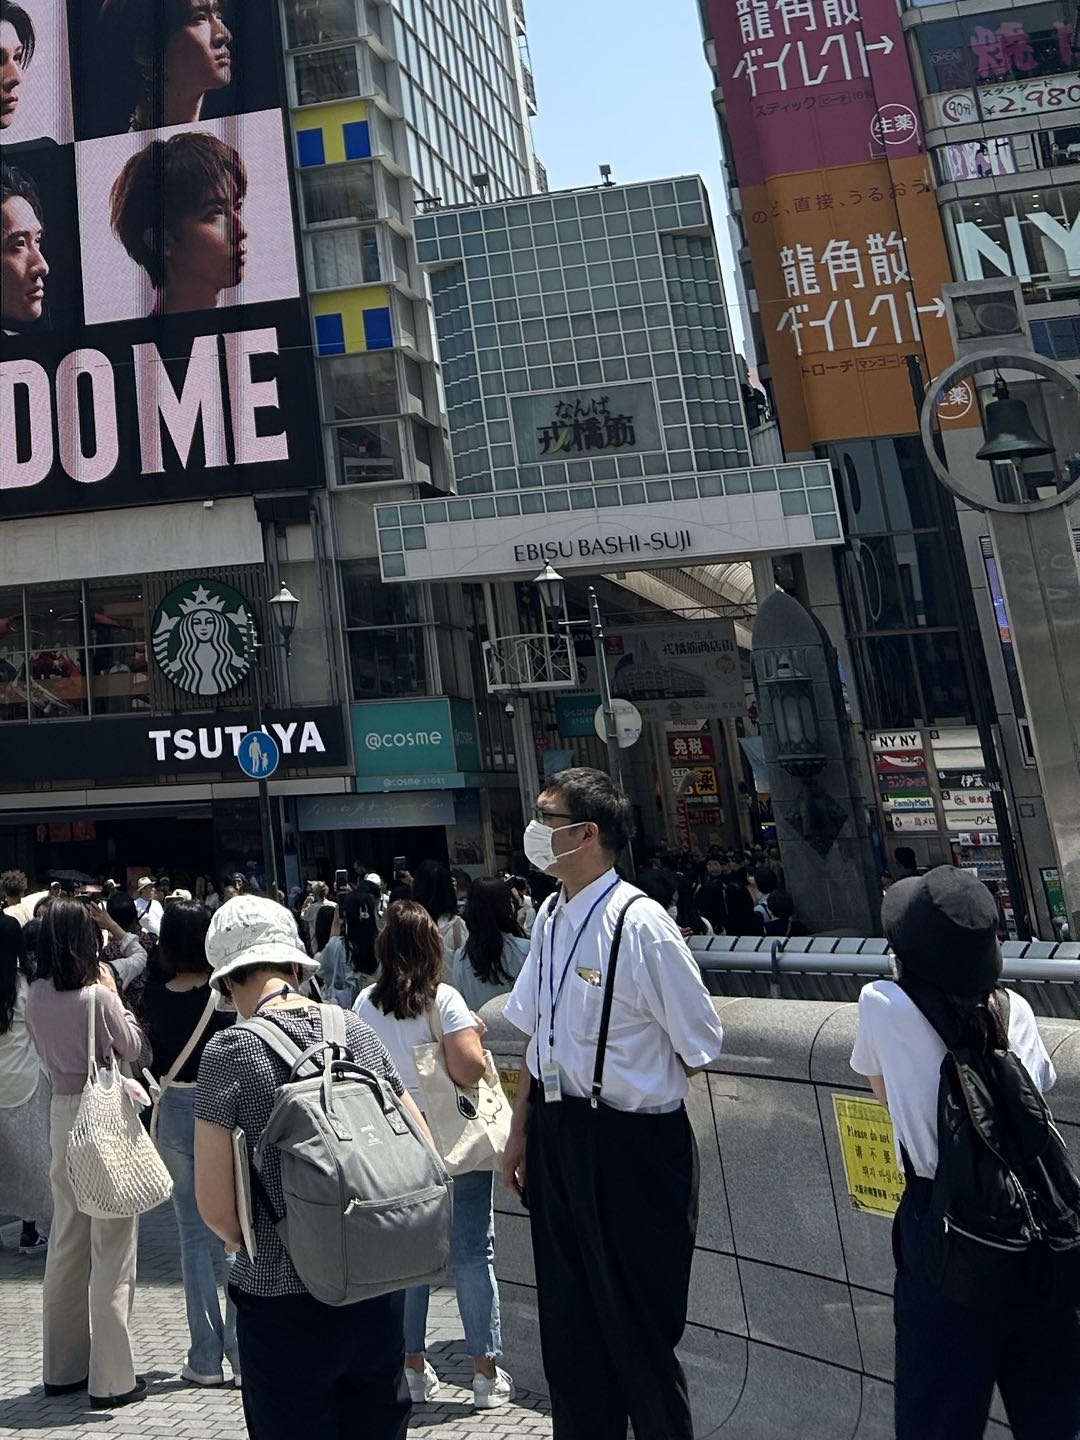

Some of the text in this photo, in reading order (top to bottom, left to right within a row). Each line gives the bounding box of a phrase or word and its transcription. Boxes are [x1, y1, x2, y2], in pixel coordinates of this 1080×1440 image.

[732, 31, 894, 97] ダイレクト
[982, 80, 1054, 97] スタンダード
[874, 114, 914, 137] 生薬
[780, 231, 914, 298] 龍角散
[776, 291, 946, 356] ダイレクト
[801, 361, 854, 378] トローチ
[555, 396, 610, 419] なんば
[536, 415, 636, 455] 戎橋筋
[514, 540, 573, 562] EBISU
[148, 721, 326, 760] TSUTYA
[365, 731, 442, 750] @cosme
[672, 738, 703, 755] 免税
[880, 737, 896, 747] NY
[900, 735, 917, 746] NY
[894, 799, 931, 809] FamilyMart
